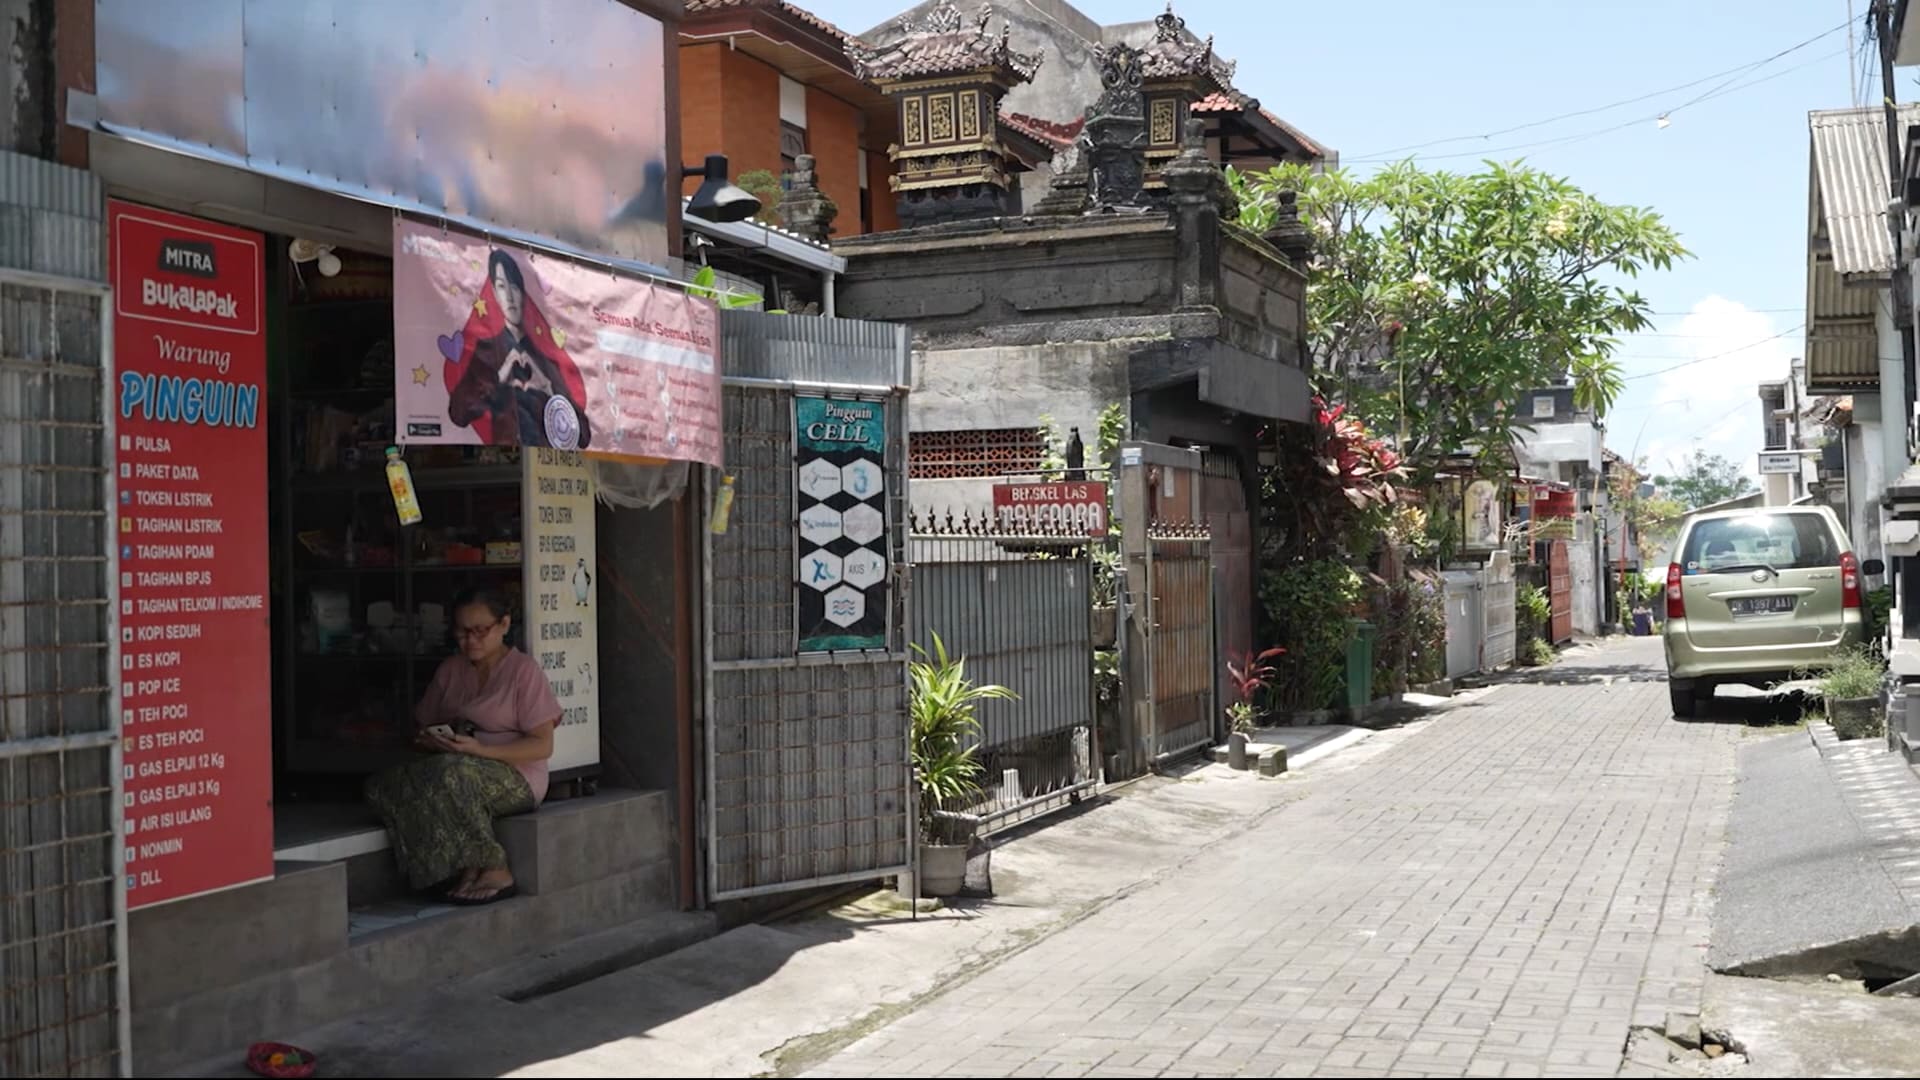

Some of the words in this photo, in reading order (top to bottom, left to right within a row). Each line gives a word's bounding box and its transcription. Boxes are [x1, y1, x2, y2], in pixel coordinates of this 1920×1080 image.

[165, 247, 213, 272] MITRA
[153, 335, 231, 375] Warung
[120, 371, 259, 428] PINGUIN
[806, 422, 870, 443] CELL
[136, 436, 171, 452] PULSA
[136, 464, 170, 479] PAKET
[172, 465, 199, 480] DATA
[853, 466, 869, 495] 3
[136, 490, 173, 506] TOKEN
[175, 492, 213, 507] LISTRIK
[136, 517, 183, 533] TAGIHAN
[185, 519, 223, 533] LISTRIK
[137, 545, 183, 559] TAGIHAN
[185, 545, 214, 559] PDAM
[137, 572, 183, 586] TAGIHAN
[185, 572, 212, 585] BPJS
[812, 558, 836, 583] XL
[138, 599, 178, 614] TAGIHAN
[180, 598, 216, 613] TELKOM
[222, 595, 263, 610] INDIHOME
[138, 626, 164, 641] KOPI
[166, 624, 201, 639] SEDUH
[138, 653, 152, 668] ES
[155, 652, 181, 667] KOPI
[138, 679, 160, 695] POP
[163, 678, 181, 692] ICE
[139, 708, 159, 723] TEH
[162, 704, 188, 720] POCI
[139, 735, 153, 750] ES
[156, 732, 177, 748] TEH
[179, 728, 204, 746] POCI
[139, 760, 161, 777] GAS
[198, 754, 209, 769] 12
[212, 752, 225, 769] Kg
[140, 787, 162, 804] GAS
[198, 781, 205, 795] 3
[206, 779, 220, 796] Kg
[140, 814, 160, 833] AIR
[161, 811, 175, 828] ISI
[177, 806, 212, 826] ULANG
[140, 838, 183, 859] NONMIN
[141, 870, 163, 887] DLL
